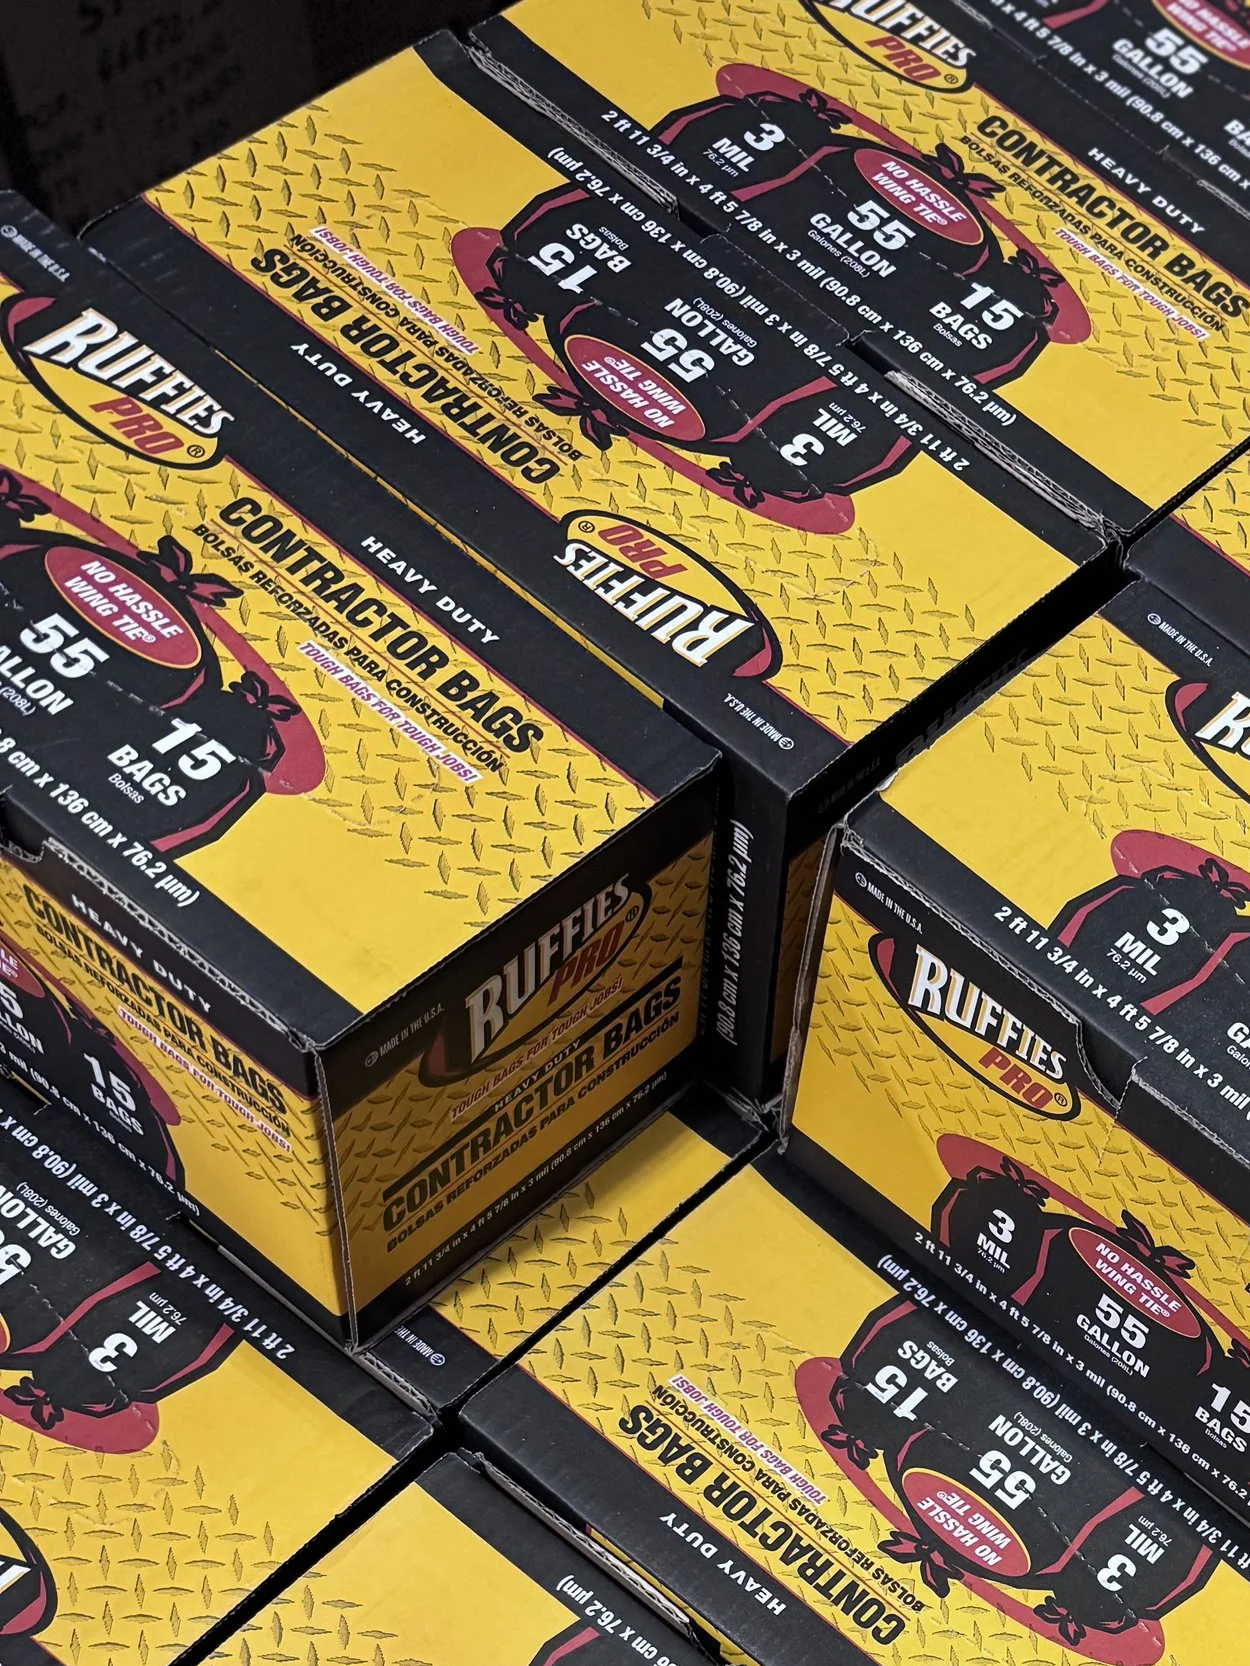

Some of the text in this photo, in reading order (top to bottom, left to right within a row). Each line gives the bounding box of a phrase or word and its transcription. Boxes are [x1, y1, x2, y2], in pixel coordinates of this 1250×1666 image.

[1113, 39, 1193, 98] GALLON
[1145, 27, 1208, 73] 55
[809, 212, 897, 278] GALLON
[847, 198, 917, 250] 55
[977, 115, 1250, 319] CONTRACTOR BAGS
[1087, 150, 1205, 236] HEAVY DUTY
[21, 306, 239, 438] RUFFIES
[289, 344, 426, 448] HEAVY DUTY
[218, 496, 544, 754] CONTRACTOR BAGS
[548, 542, 752, 672] RUFFIES
[465, 874, 630, 1063] RUFFIES
[907, 943, 1067, 1080] RUFFIES
[383, 975, 683, 1233] CONTRACTOR BAGS
[89, 1332, 138, 1372] 3
[128, 1299, 177, 1344] MIL
